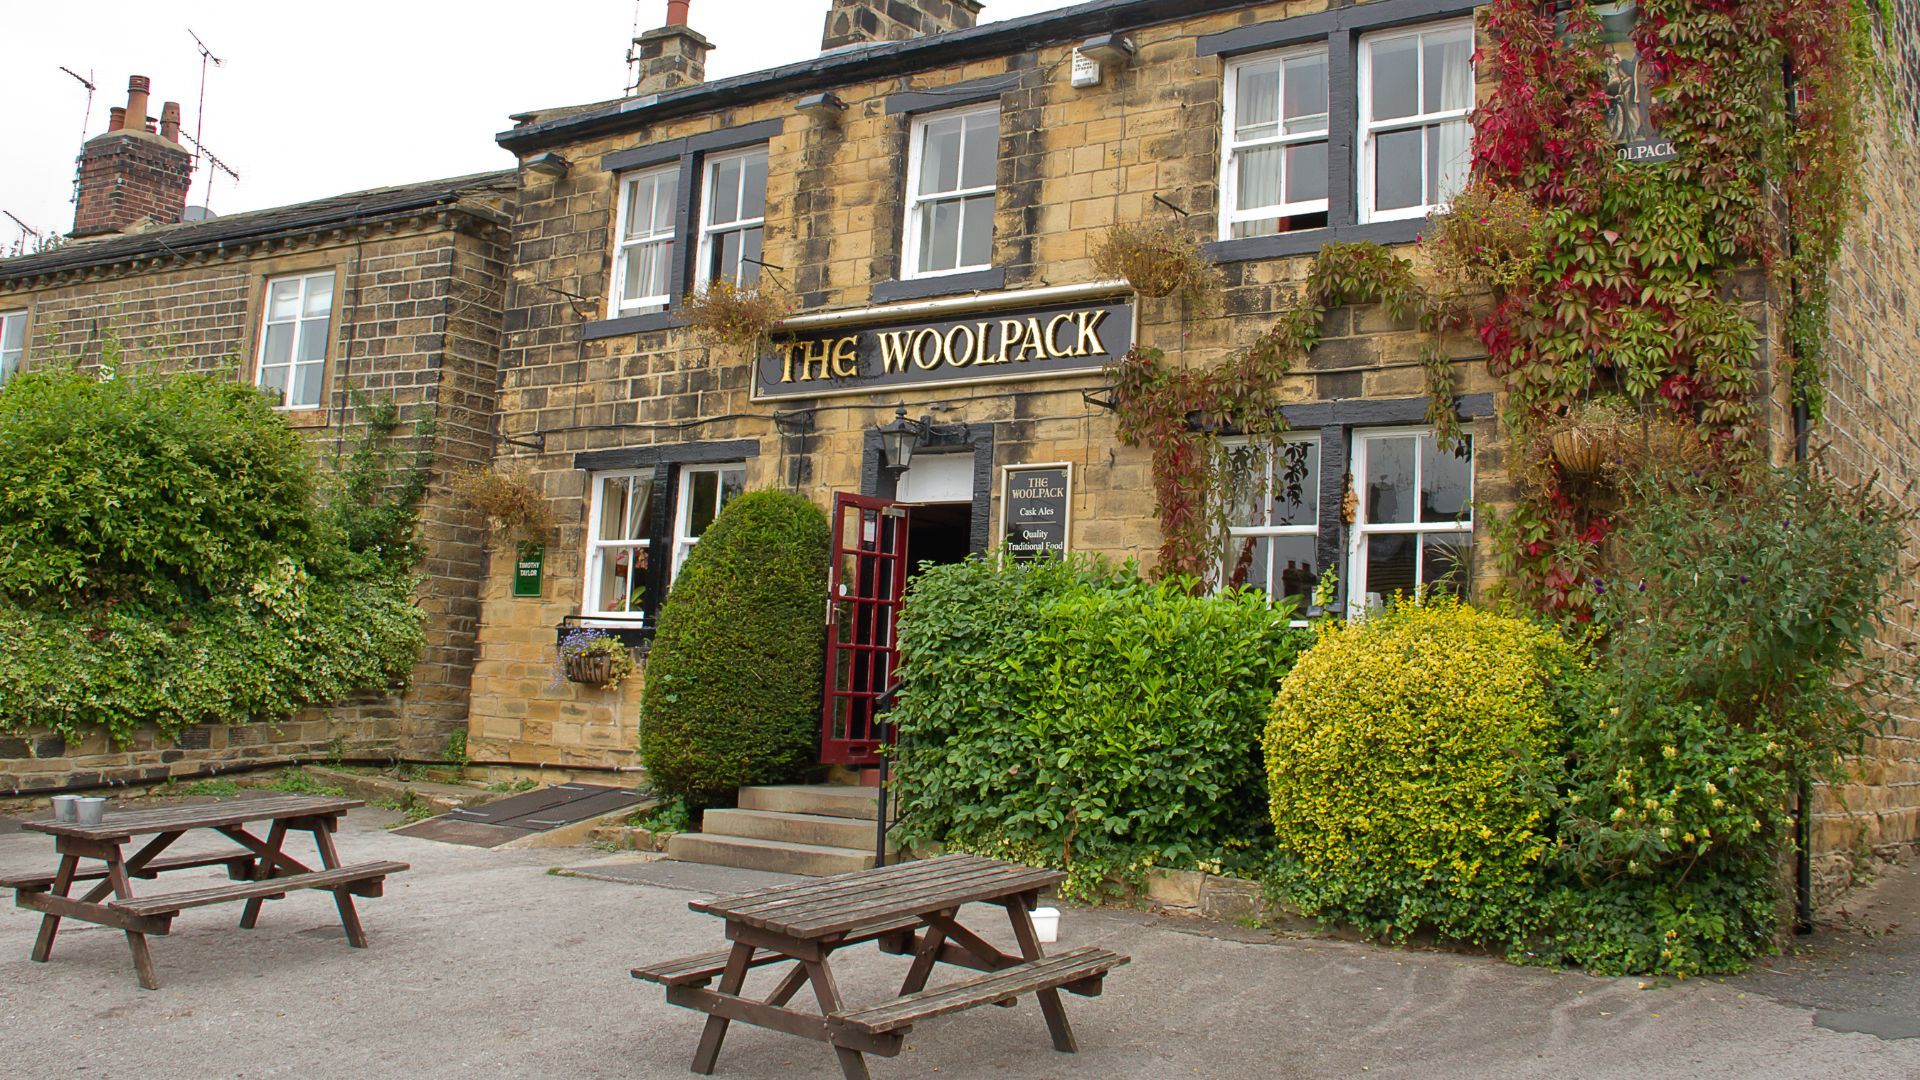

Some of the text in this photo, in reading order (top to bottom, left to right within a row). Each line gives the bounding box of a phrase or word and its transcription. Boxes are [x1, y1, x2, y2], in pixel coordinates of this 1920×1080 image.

[1617, 142, 1677, 160] OLPACK
[776, 309, 1107, 383] THE WOOLPACK
[1028, 478, 1048, 488] THE
[1012, 487, 1064, 499] WOOLPACK
[1019, 506, 1054, 516] Cask Ales
[1022, 530, 1048, 540] Quality
[1008, 541, 1063, 551] Traditional Food
[520, 569, 538, 577] TAYLOR
